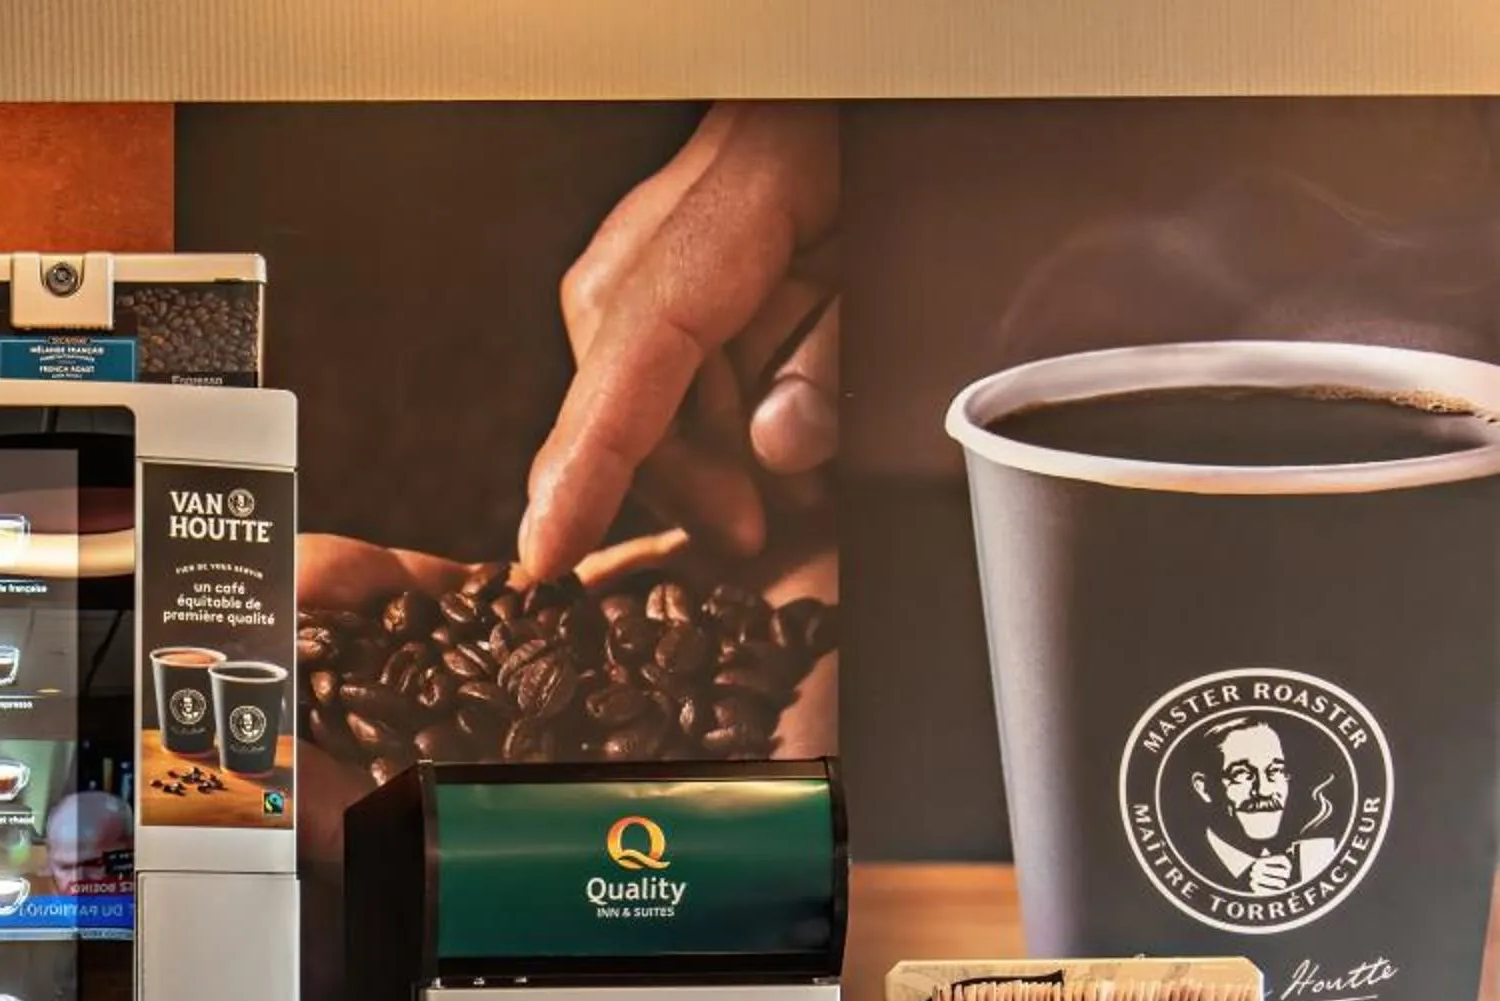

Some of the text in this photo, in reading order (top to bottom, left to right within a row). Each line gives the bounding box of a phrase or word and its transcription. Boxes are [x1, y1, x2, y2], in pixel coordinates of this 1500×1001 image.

[169, 491, 224, 515] VAN
[169, 515, 271, 543] HOUTTE
[177, 592, 262, 610] équitable de
[193, 581, 245, 595] un café
[163, 609, 276, 627] première qualité
[1144, 681, 1369, 754] MASTER ROASTER
[1132, 796, 1382, 921] MAÎTRE TORRÉFACTEUR
[586, 876, 687, 905] Quality
[597, 907, 675, 918] INN & SUITES
[1280, 957, 1399, 1001] Houtte
